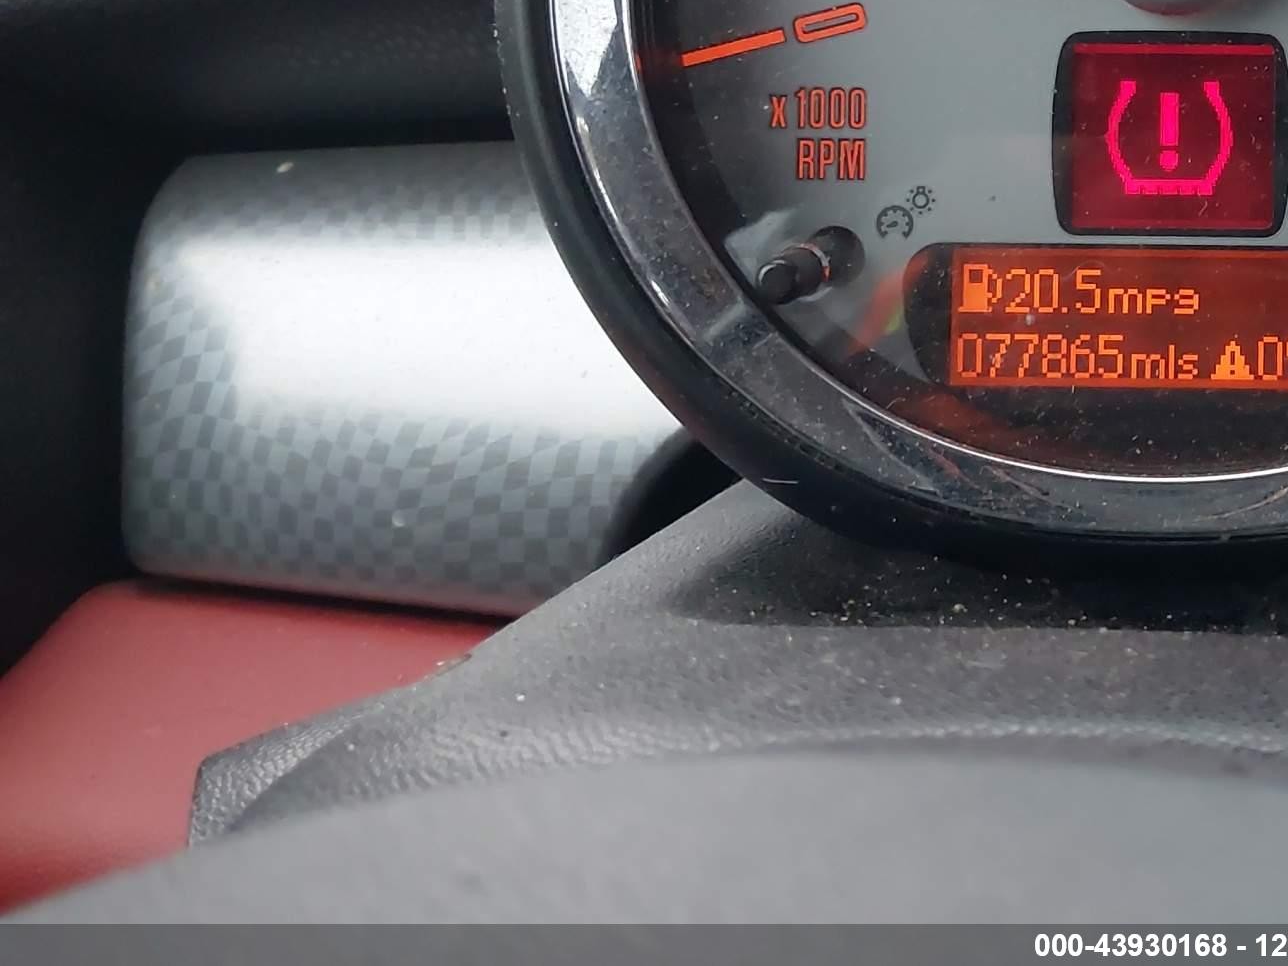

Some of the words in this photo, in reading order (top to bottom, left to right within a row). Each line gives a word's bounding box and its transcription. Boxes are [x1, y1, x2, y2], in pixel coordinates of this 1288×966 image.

[793, 1, 868, 44] 0
[796, 137, 867, 181] RPM
[1004, 268, 1102, 314] 20.5
[1107, 287, 1200, 315] mpg
[957, 333, 1125, 379] 077865
